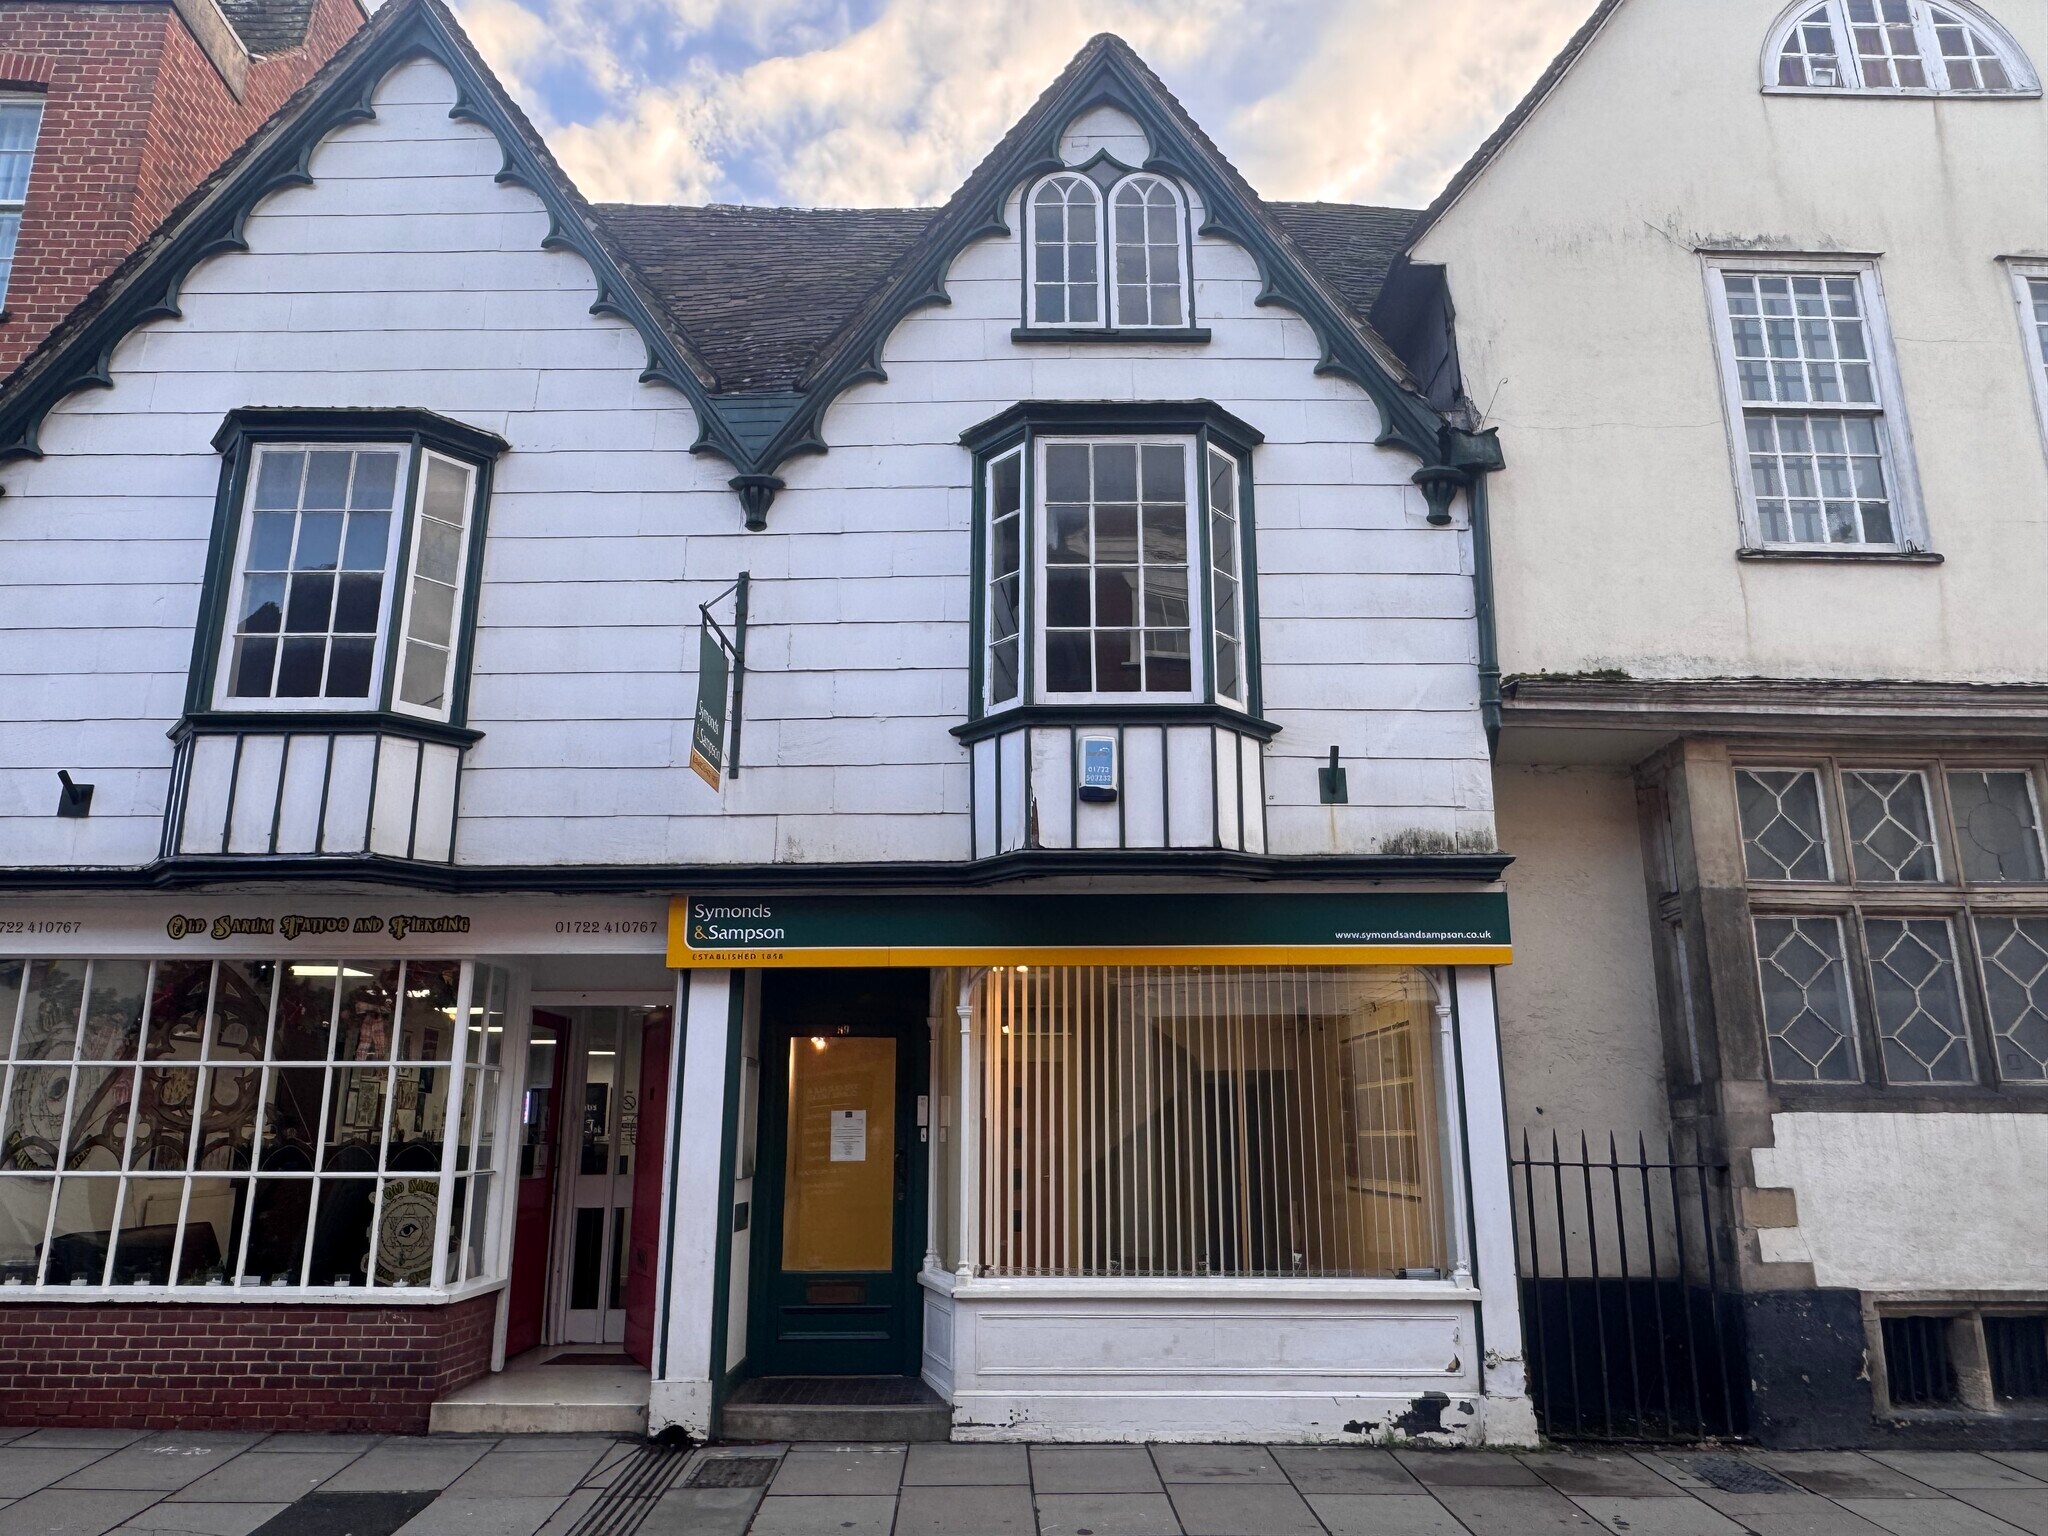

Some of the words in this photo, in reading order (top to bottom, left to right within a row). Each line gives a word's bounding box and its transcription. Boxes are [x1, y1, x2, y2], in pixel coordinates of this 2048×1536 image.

[694, 903, 772, 922] Symonds
[27, 921, 82, 934] 410767
[555, 921, 600, 934] 01722
[604, 921, 658, 934] 410767
[1335, 930, 1491, 940] www.symondsandsampson.co.uk
